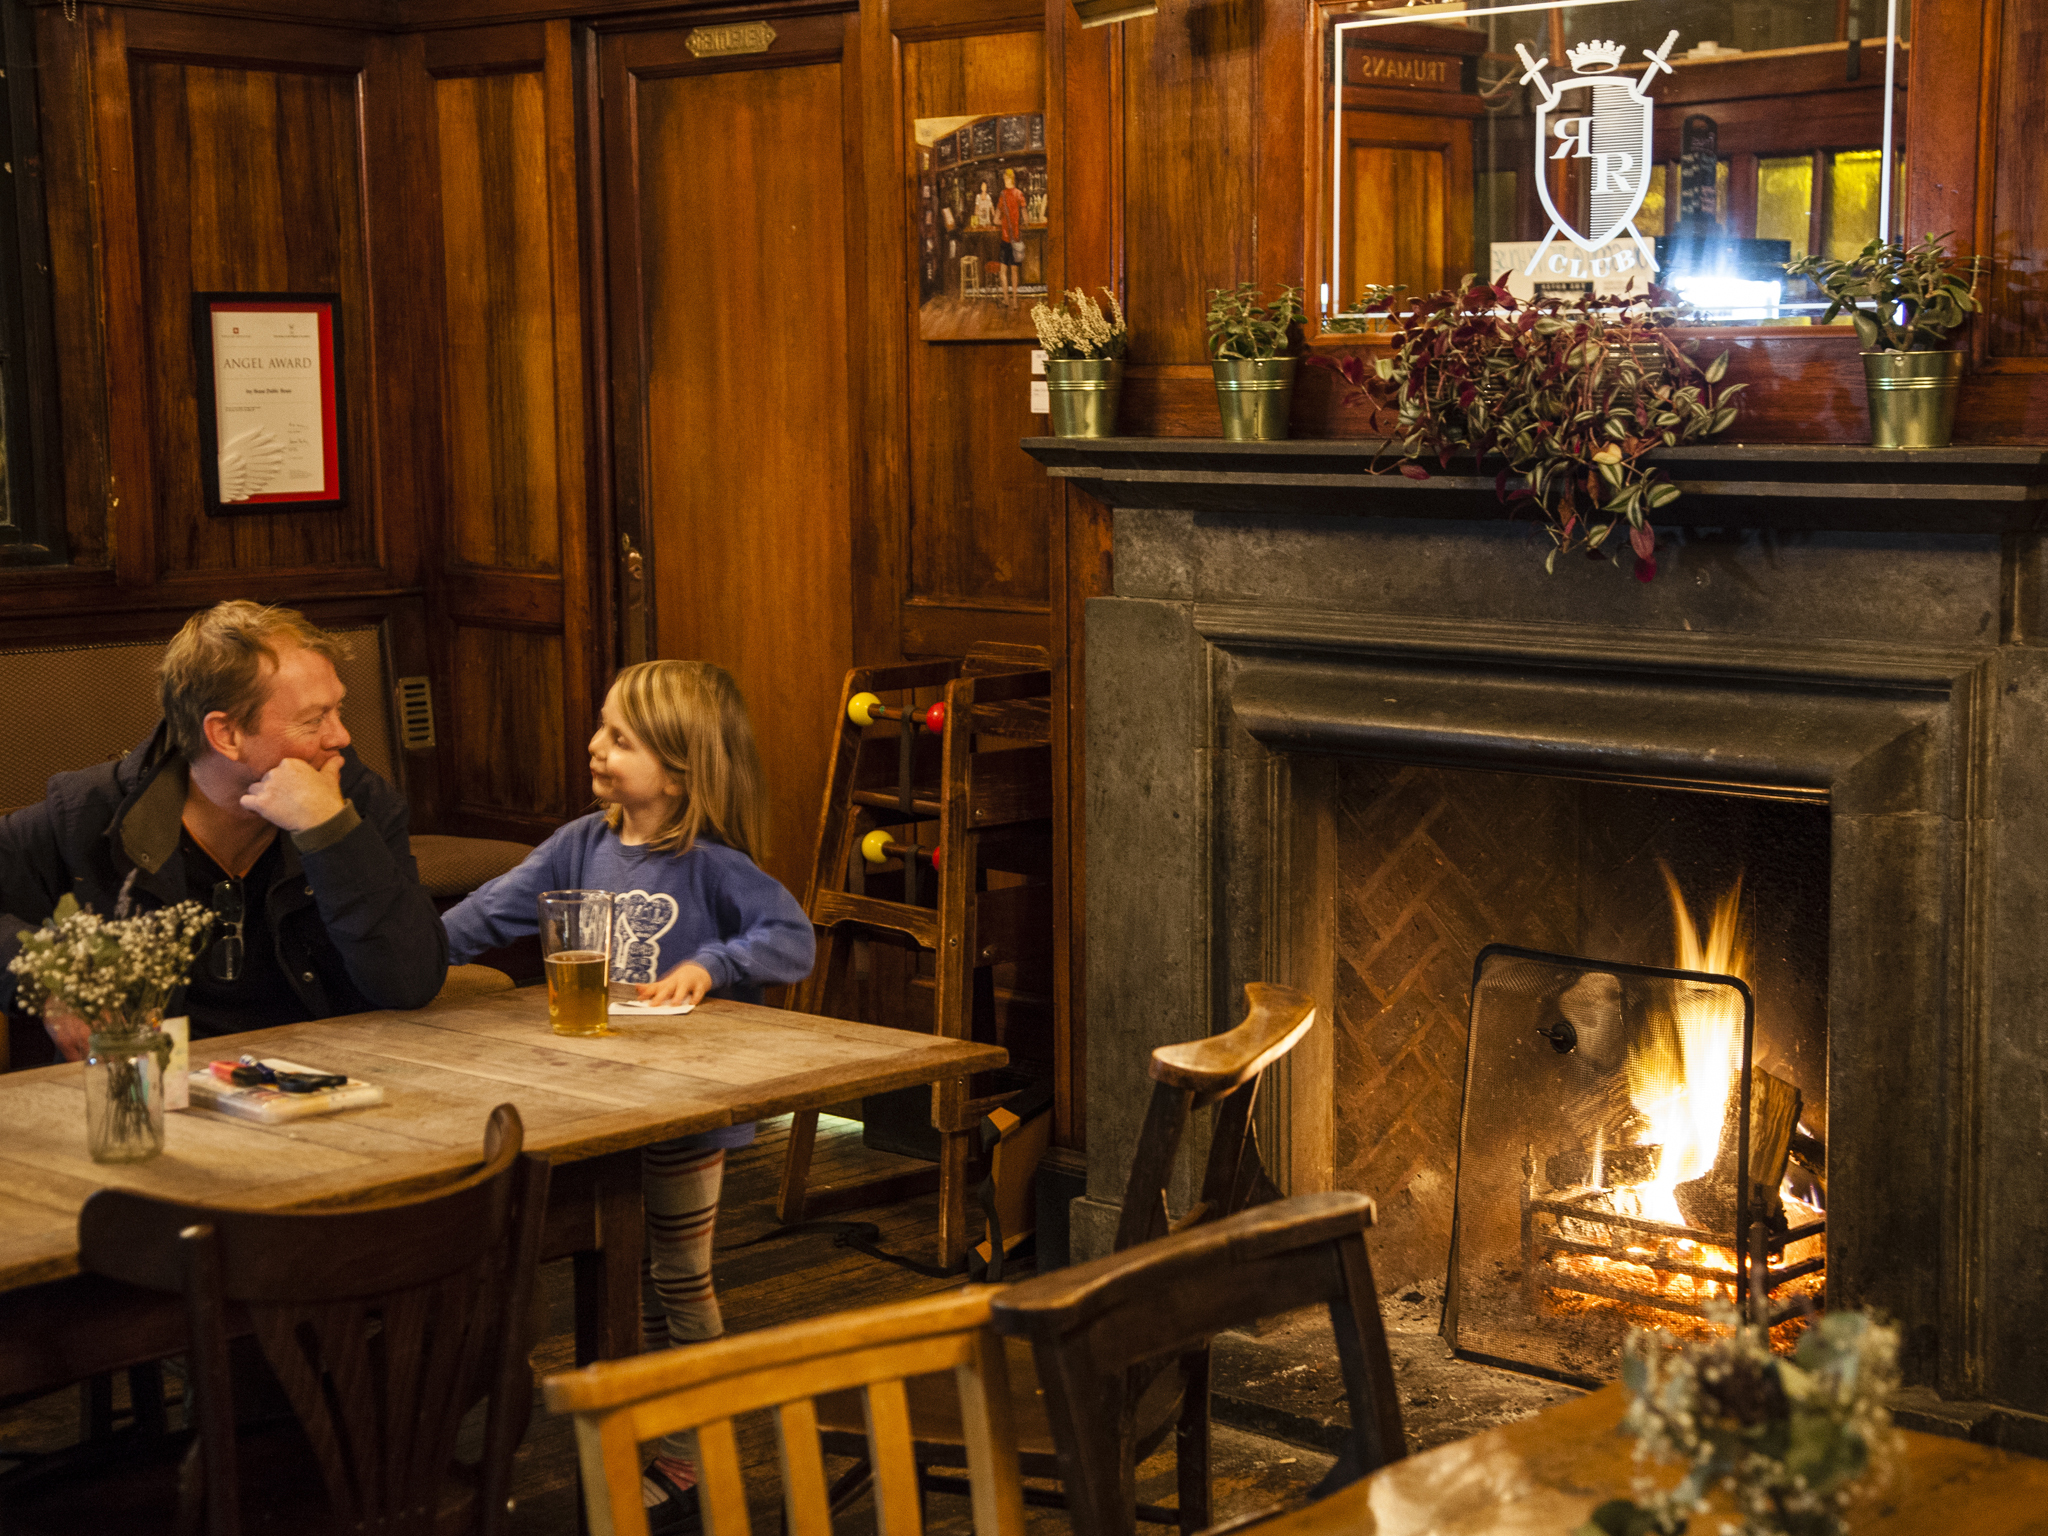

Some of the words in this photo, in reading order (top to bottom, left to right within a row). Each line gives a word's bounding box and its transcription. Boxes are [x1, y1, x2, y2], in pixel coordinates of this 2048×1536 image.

[1591, 152, 1638, 193] R
[1548, 249, 1636, 279] CLUB
[224, 357, 264, 369] ANGEL
[269, 357, 312, 369] AWARD
